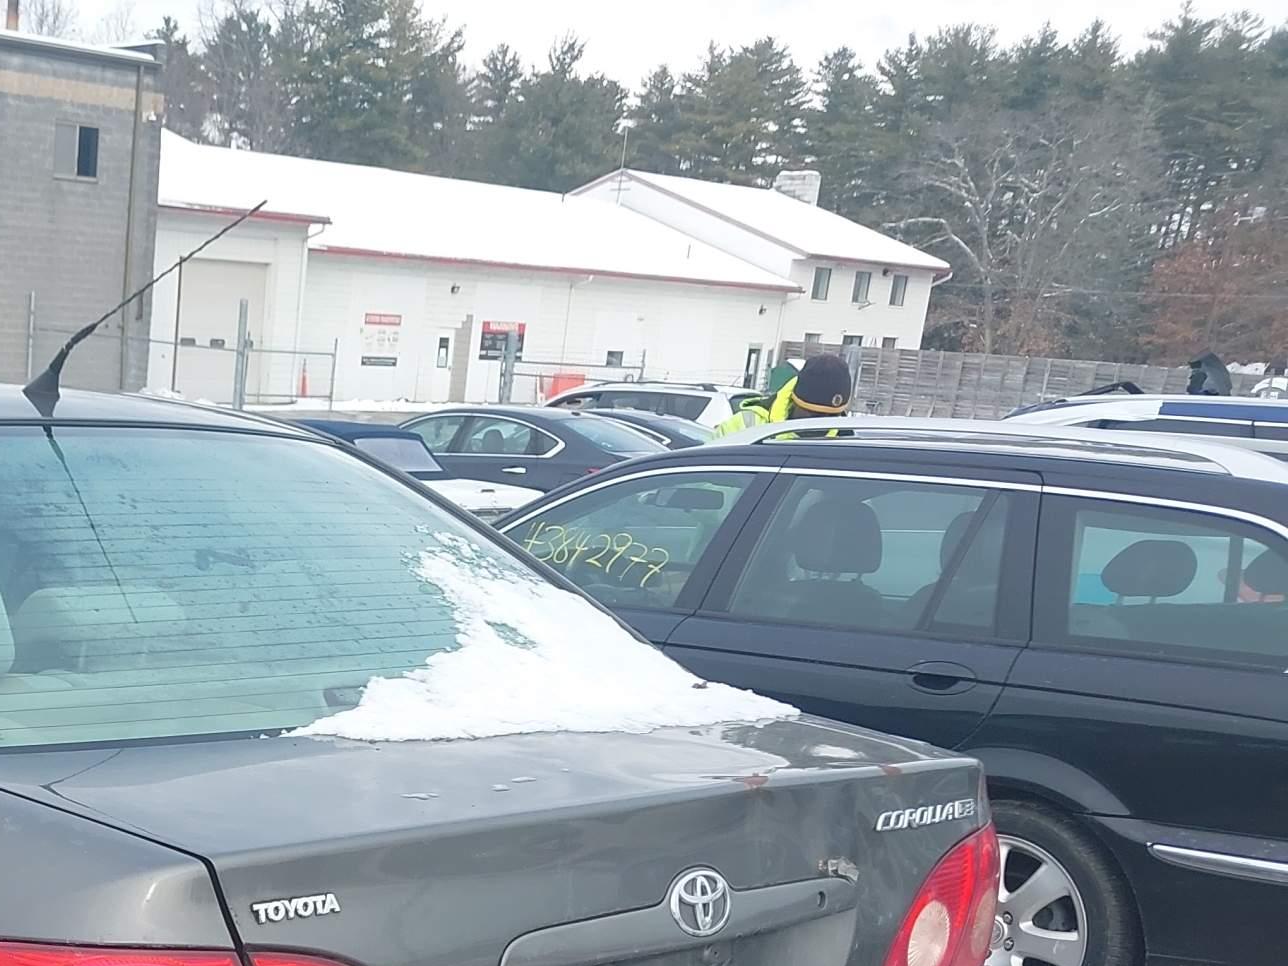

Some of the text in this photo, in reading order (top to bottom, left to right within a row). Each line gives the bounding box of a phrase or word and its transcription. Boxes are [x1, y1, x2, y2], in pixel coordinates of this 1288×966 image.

[524, 521, 669, 588] 43842977
[875, 801, 954, 832] COROLLA
[251, 893, 341, 925] TOYOTA
